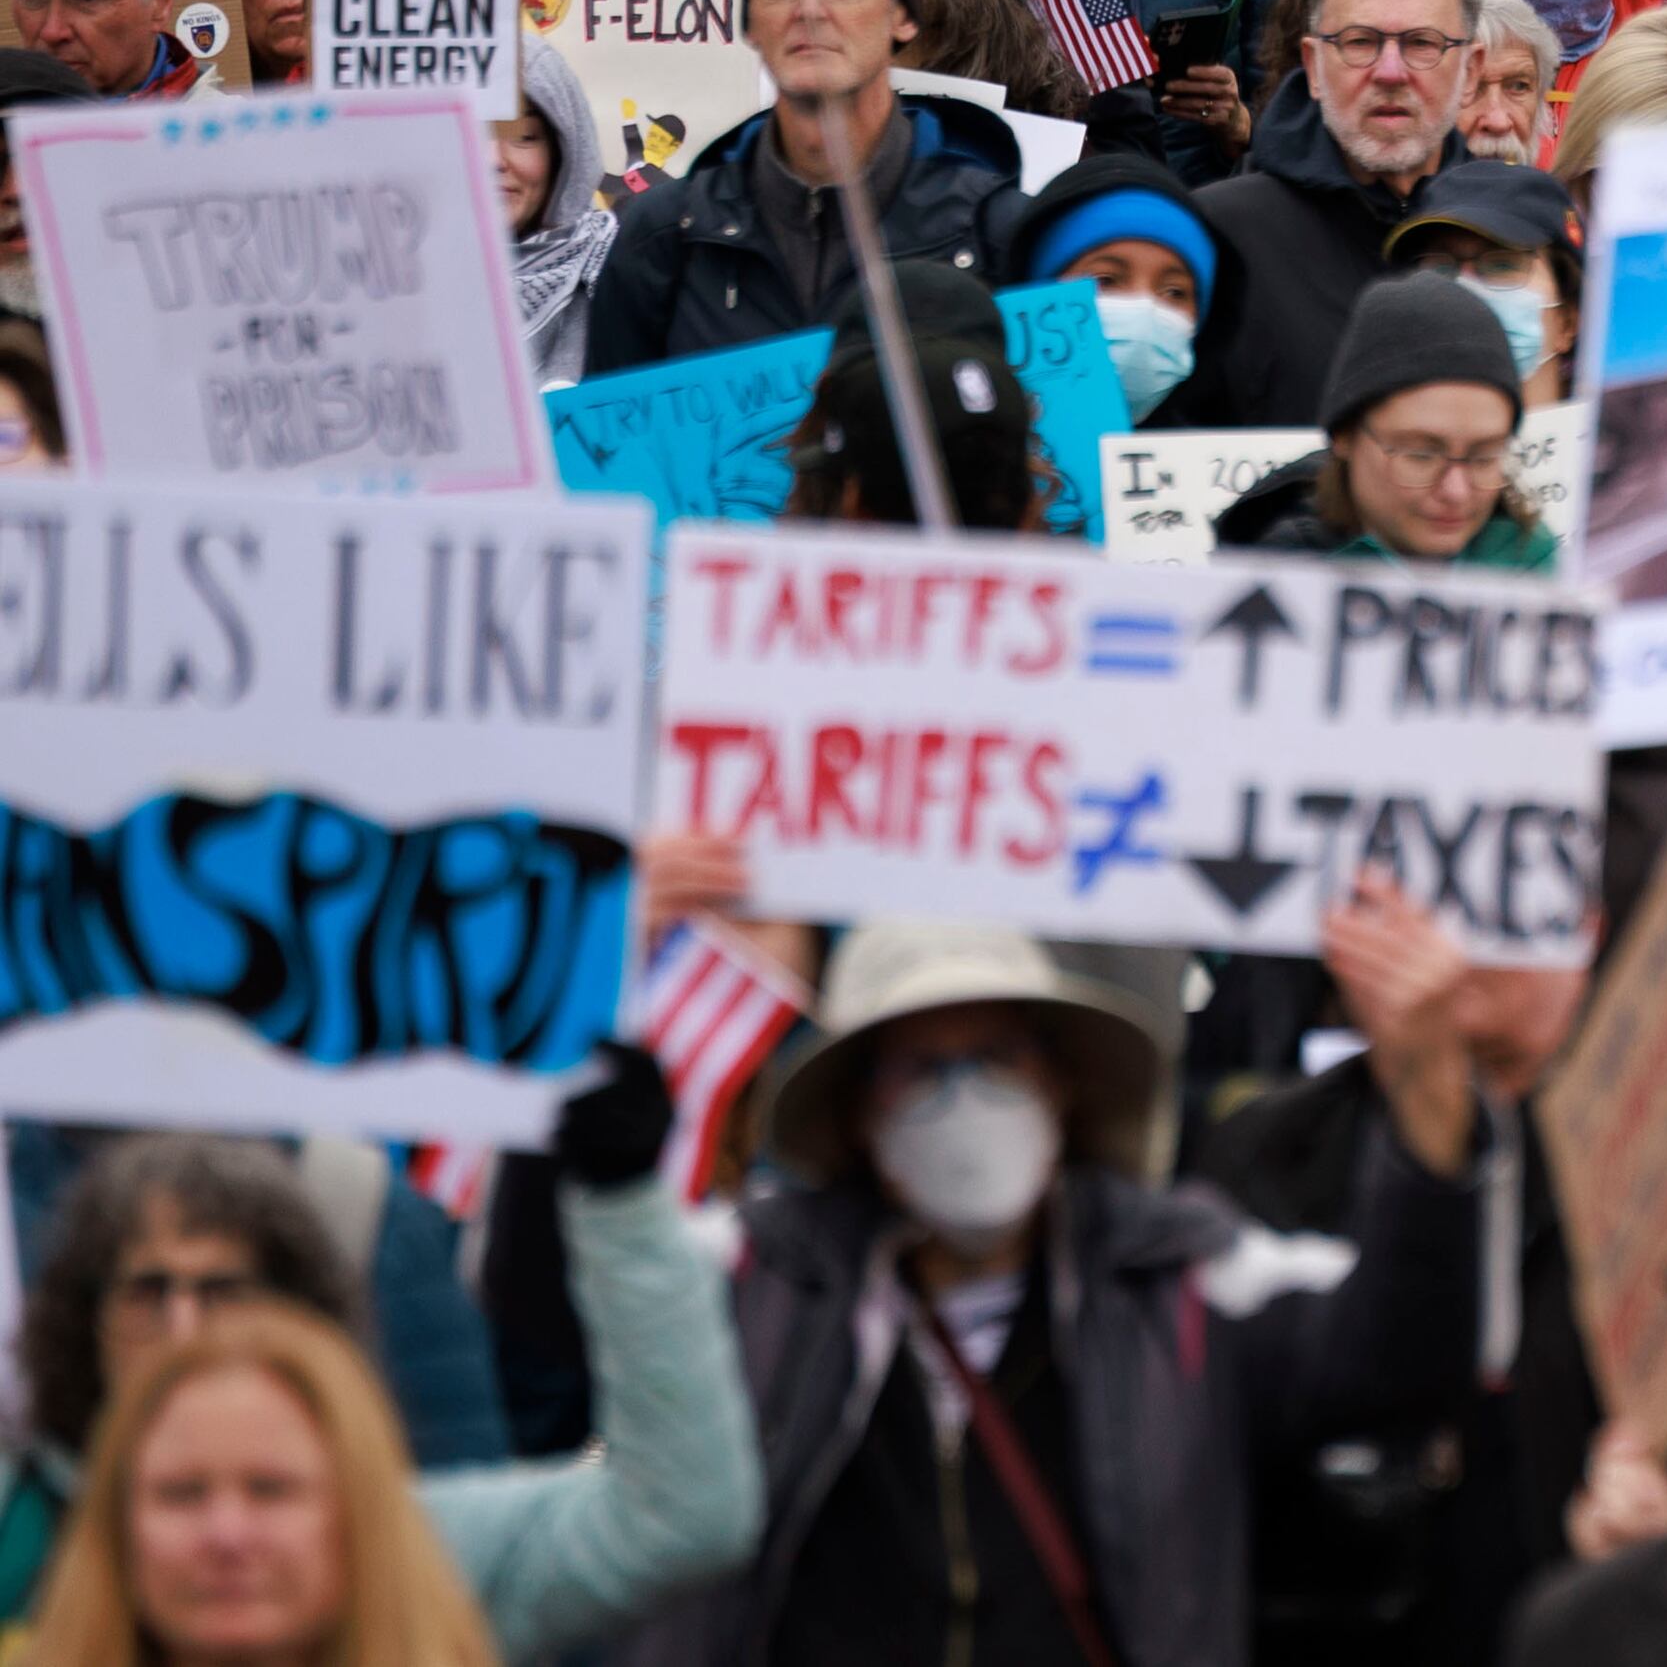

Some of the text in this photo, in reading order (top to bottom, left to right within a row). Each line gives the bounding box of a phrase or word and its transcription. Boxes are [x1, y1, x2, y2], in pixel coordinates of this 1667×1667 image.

[331, 45, 496, 90] ENERGY
[105, 180, 429, 313] TRUMP
[206, 361, 461, 471] PRISON
[329, 528, 623, 724] LIKE
[695, 558, 1067, 678] TARIFFS
[1327, 586, 1600, 724] PRICES
[673, 726, 1600, 940] TARIFFS TAXES
